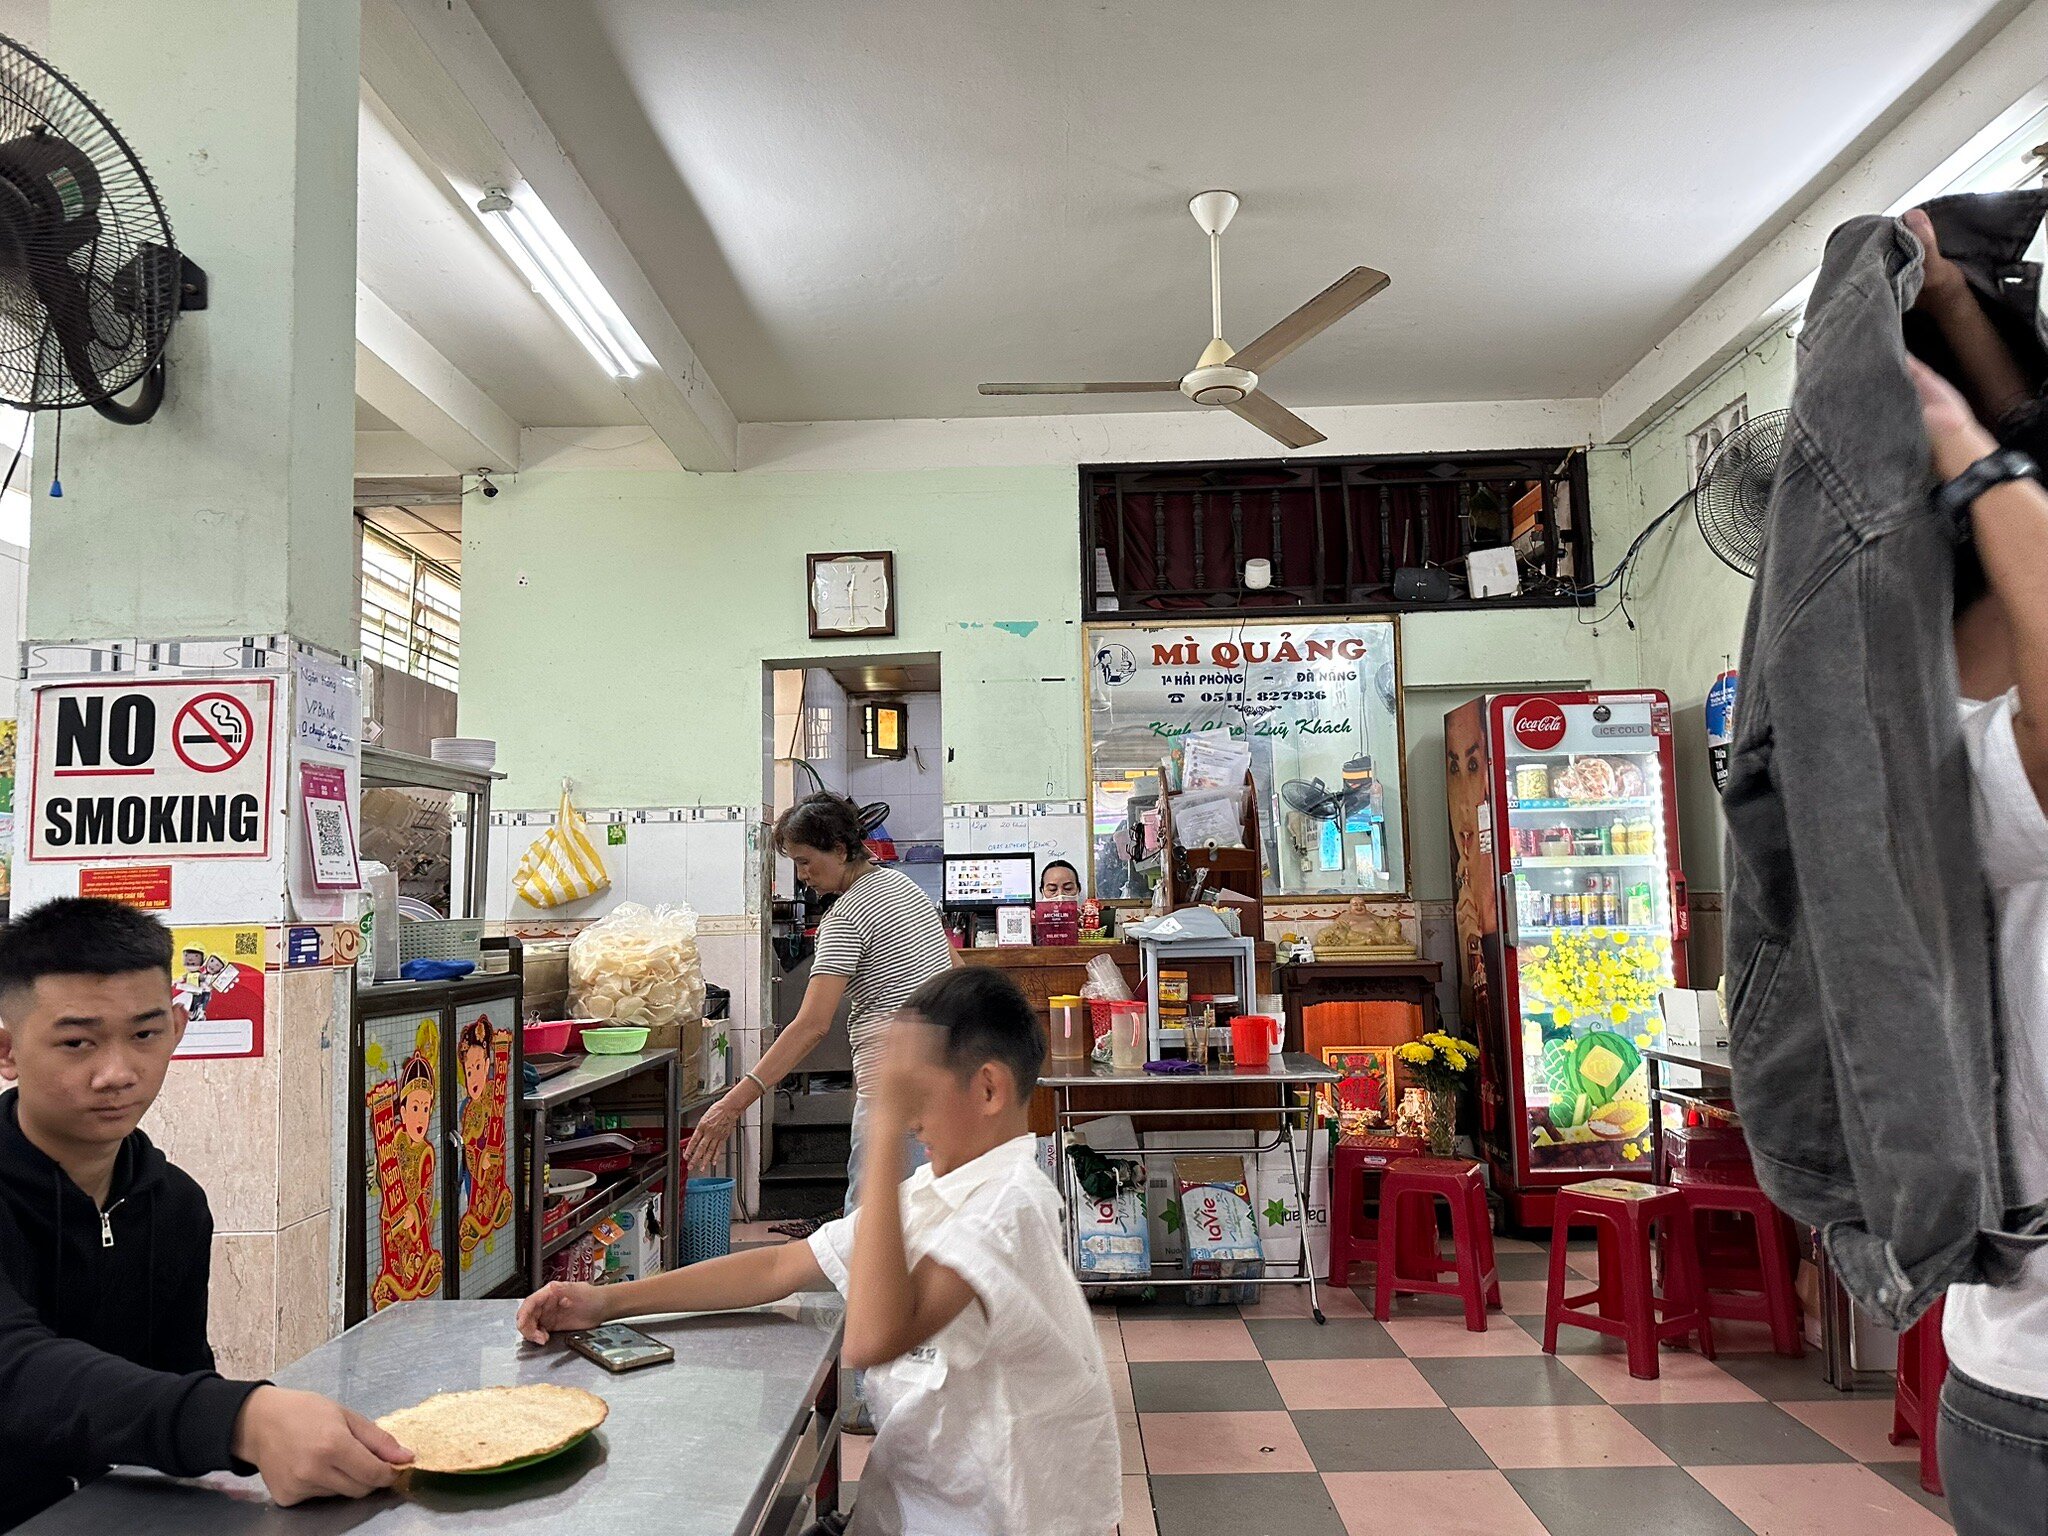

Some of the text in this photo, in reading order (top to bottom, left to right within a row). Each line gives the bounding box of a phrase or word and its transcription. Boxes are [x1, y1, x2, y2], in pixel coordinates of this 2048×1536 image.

[1151, 632, 1367, 668] MÌ QUẢNG
[1175, 671, 1195, 686] HẢI
[1199, 671, 1244, 685] PHÒNG
[1296, 668, 1315, 682] ĐÀ
[1256, 690, 1327, 702] 827936
[55, 694, 156, 767] NO
[1294, 718, 1352, 735] Khách
[1515, 715, 1563, 733] Coca-Cola
[1600, 726, 1644, 736] ICE COLD
[44, 793, 259, 846] SMOKING
[376, 1114, 394, 1140] Chúc
[1203, 1197, 1223, 1242] laVie
